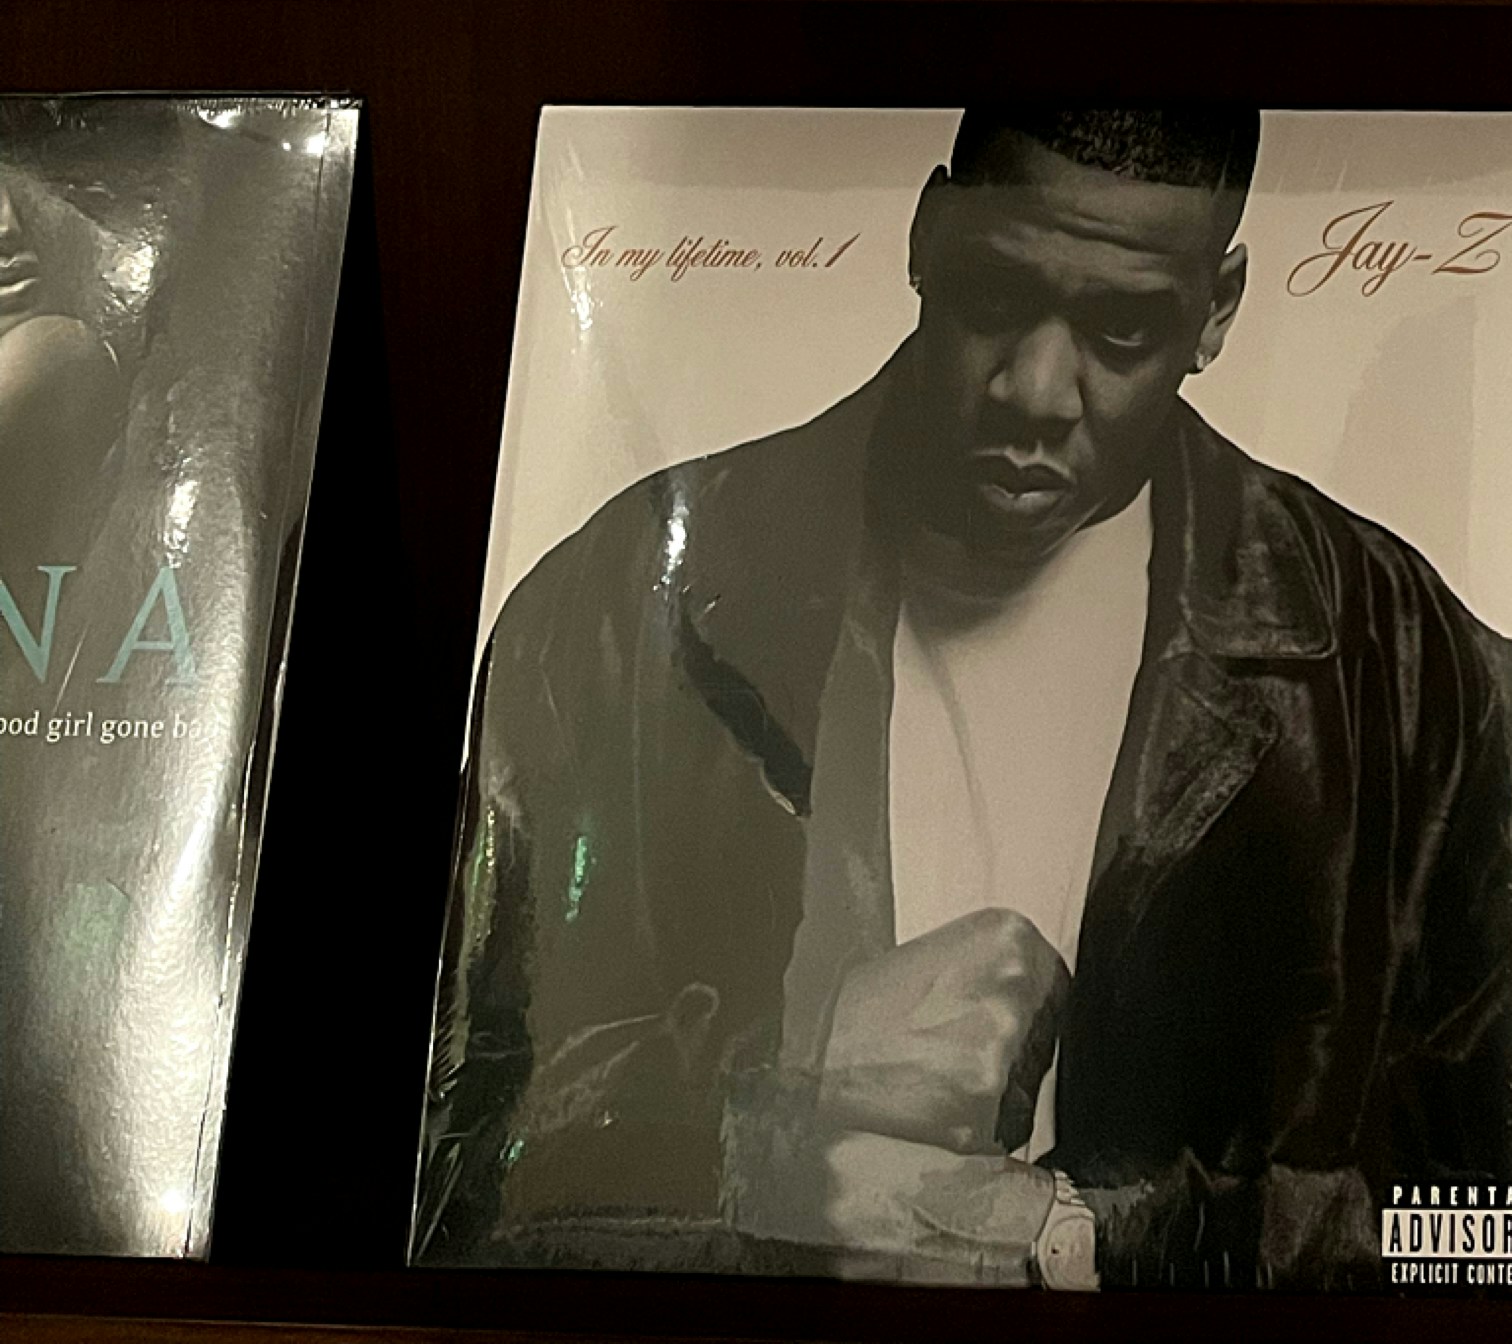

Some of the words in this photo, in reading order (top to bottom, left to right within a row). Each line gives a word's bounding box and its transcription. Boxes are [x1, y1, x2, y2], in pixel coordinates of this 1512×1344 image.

[560, 224, 620, 268] In
[615, 247, 665, 282] my
[665, 234, 762, 282] lifetime,
[45, 710, 94, 743] girl
[100, 718, 165, 744] gone
[1391, 1262, 1459, 1284] EXPLICIT
